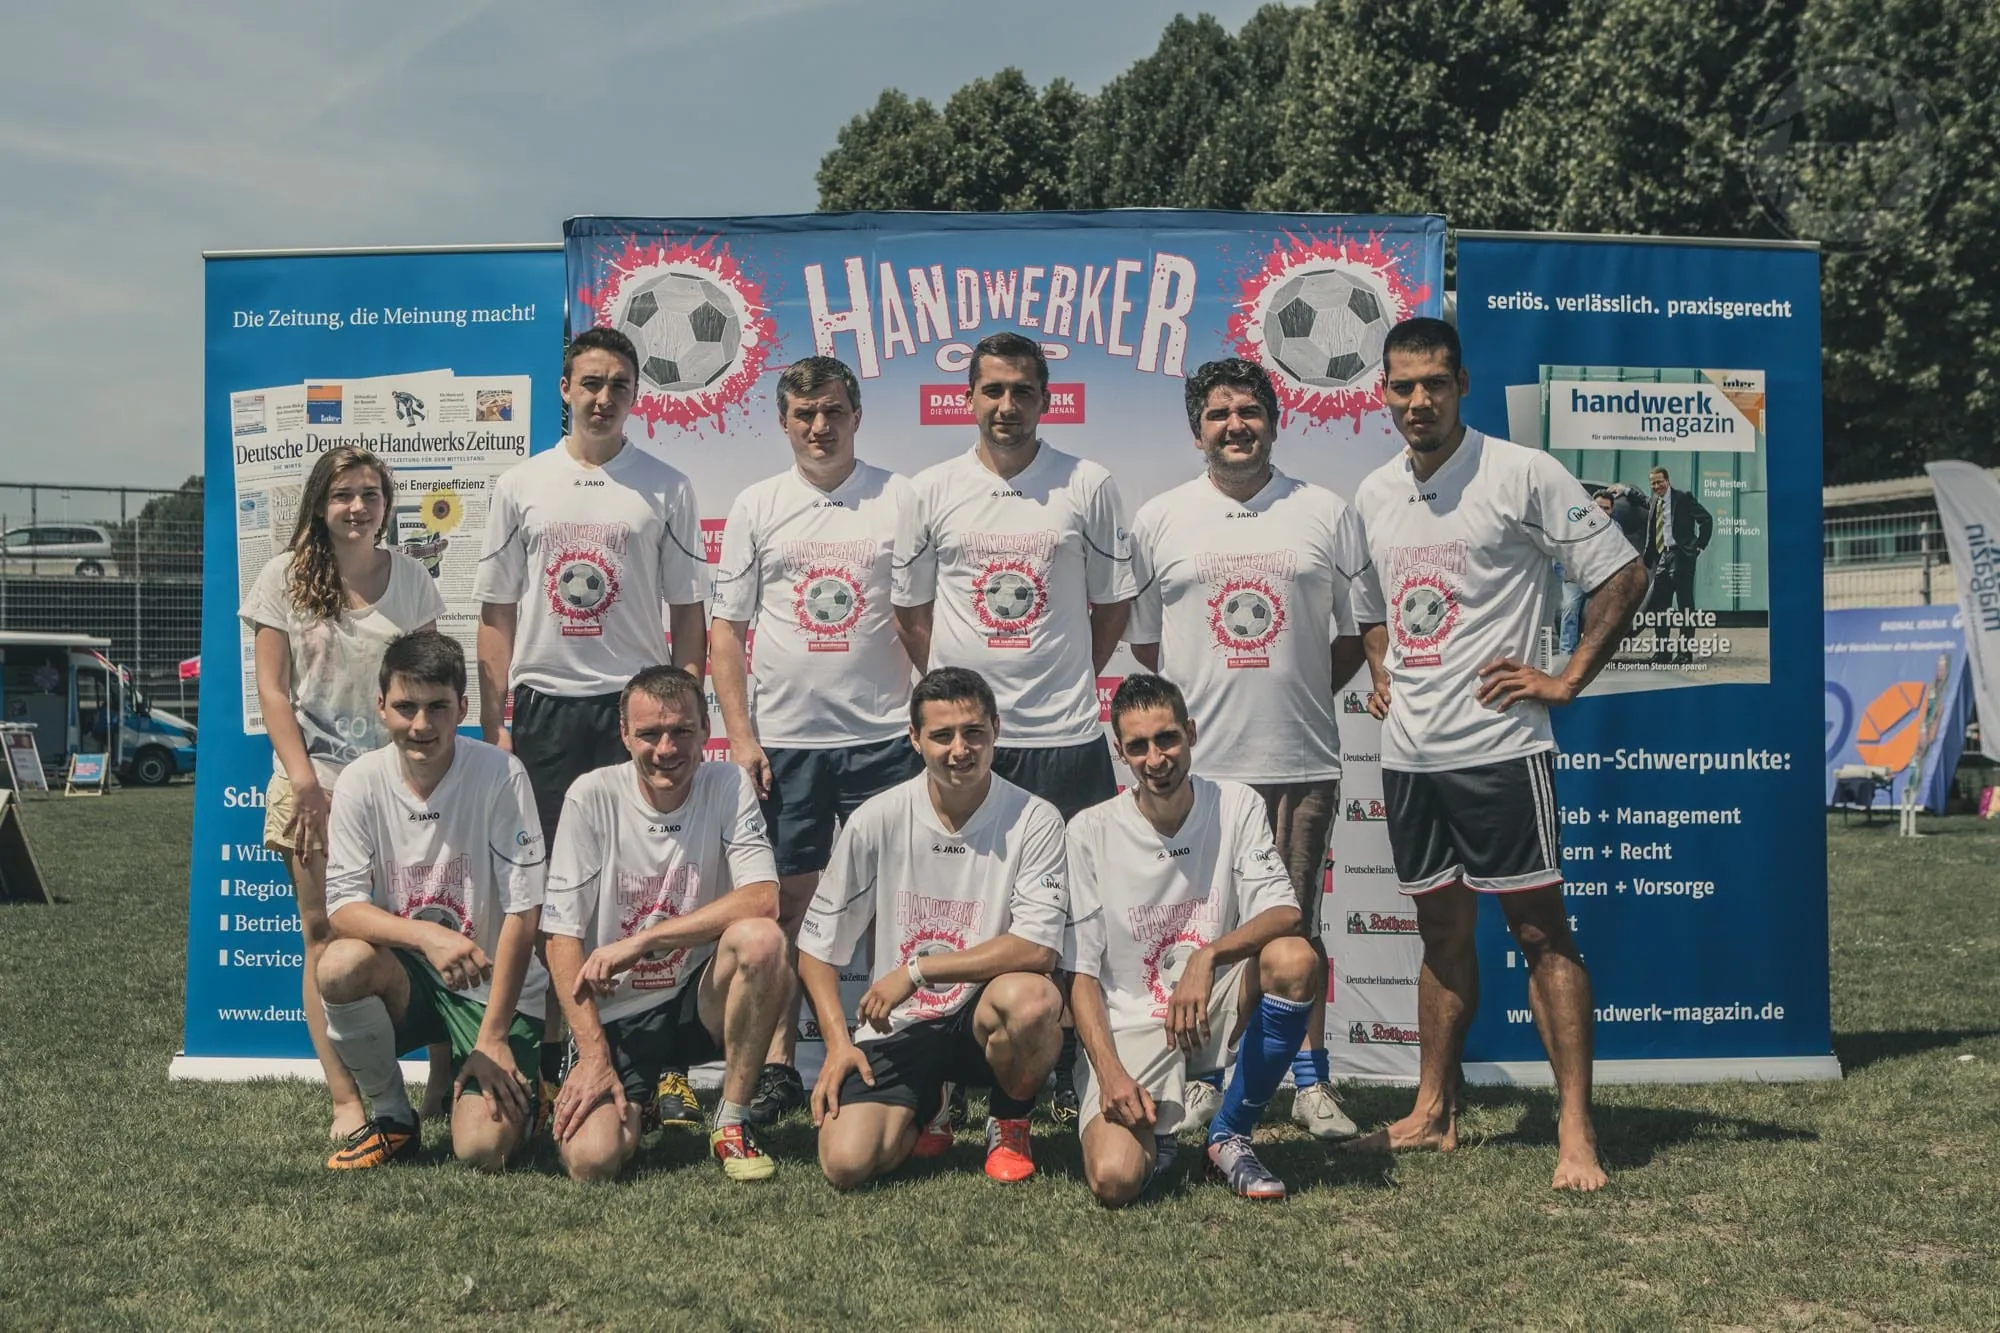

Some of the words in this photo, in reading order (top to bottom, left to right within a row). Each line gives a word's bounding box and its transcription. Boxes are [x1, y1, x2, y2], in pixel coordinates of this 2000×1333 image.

[804, 252, 1197, 378] HANDWERKER
[1487, 291, 1549, 311] seriös.
[1556, 293, 1660, 314] verlässlich.
[1667, 297, 1792, 320] praxisgerecht
[233, 310, 264, 328] Die
[268, 309, 344, 330] Zeitung,
[350, 307, 379, 326] die
[383, 306, 467, 328] Meinung
[472, 304, 536, 323] macht!
[930, 395, 966, 407] DAS
[1571, 388, 1713, 415] handwerk
[930, 408, 942, 416] DIE
[1641, 411, 1734, 438] magazin
[236, 438, 303, 465] Deutsche
[306, 433, 378, 453] Deutsche
[410, 479, 485, 492] Energieeffizienz
[1704, 489, 1731, 497] finden
[1720, 479, 1748, 489] Besten
[1418, 493, 1438, 502] JAKO
[1236, 511, 1259, 519] JAKO
[539, 521, 630, 556] HANDWERKER
[1718, 526, 1732, 536] mit
[1734, 526, 1761, 536] Pfusch
[782, 538, 877, 572] HANDWERKER
[960, 529, 1060, 564] HANDWERKER
[1194, 549, 1298, 584] HANDWERKER
[1633, 607, 1717, 631] perfekte
[1619, 633, 1731, 657] nzstrategie
[1617, 661, 1650, 673] Experten
[1651, 661, 1680, 672] Steuern
[1681, 662, 1708, 673] sparen
[1552, 748, 1791, 774] men-Schwerpunkte:
[418, 812, 440, 822] JAKO
[1616, 807, 1741, 829] Management
[660, 825, 681, 833] JAKO
[943, 846, 966, 855] JAKO
[1168, 847, 1190, 858] JAKO
[1563, 847, 1594, 860] ern
[1620, 842, 1672, 860] Recht
[386, 853, 474, 894] HNDWERKER
[1560, 882, 1608, 896] nzen
[1633, 878, 1714, 899] Vorsorge
[234, 914, 303, 932] Betrieb
[233, 949, 303, 967] Service
